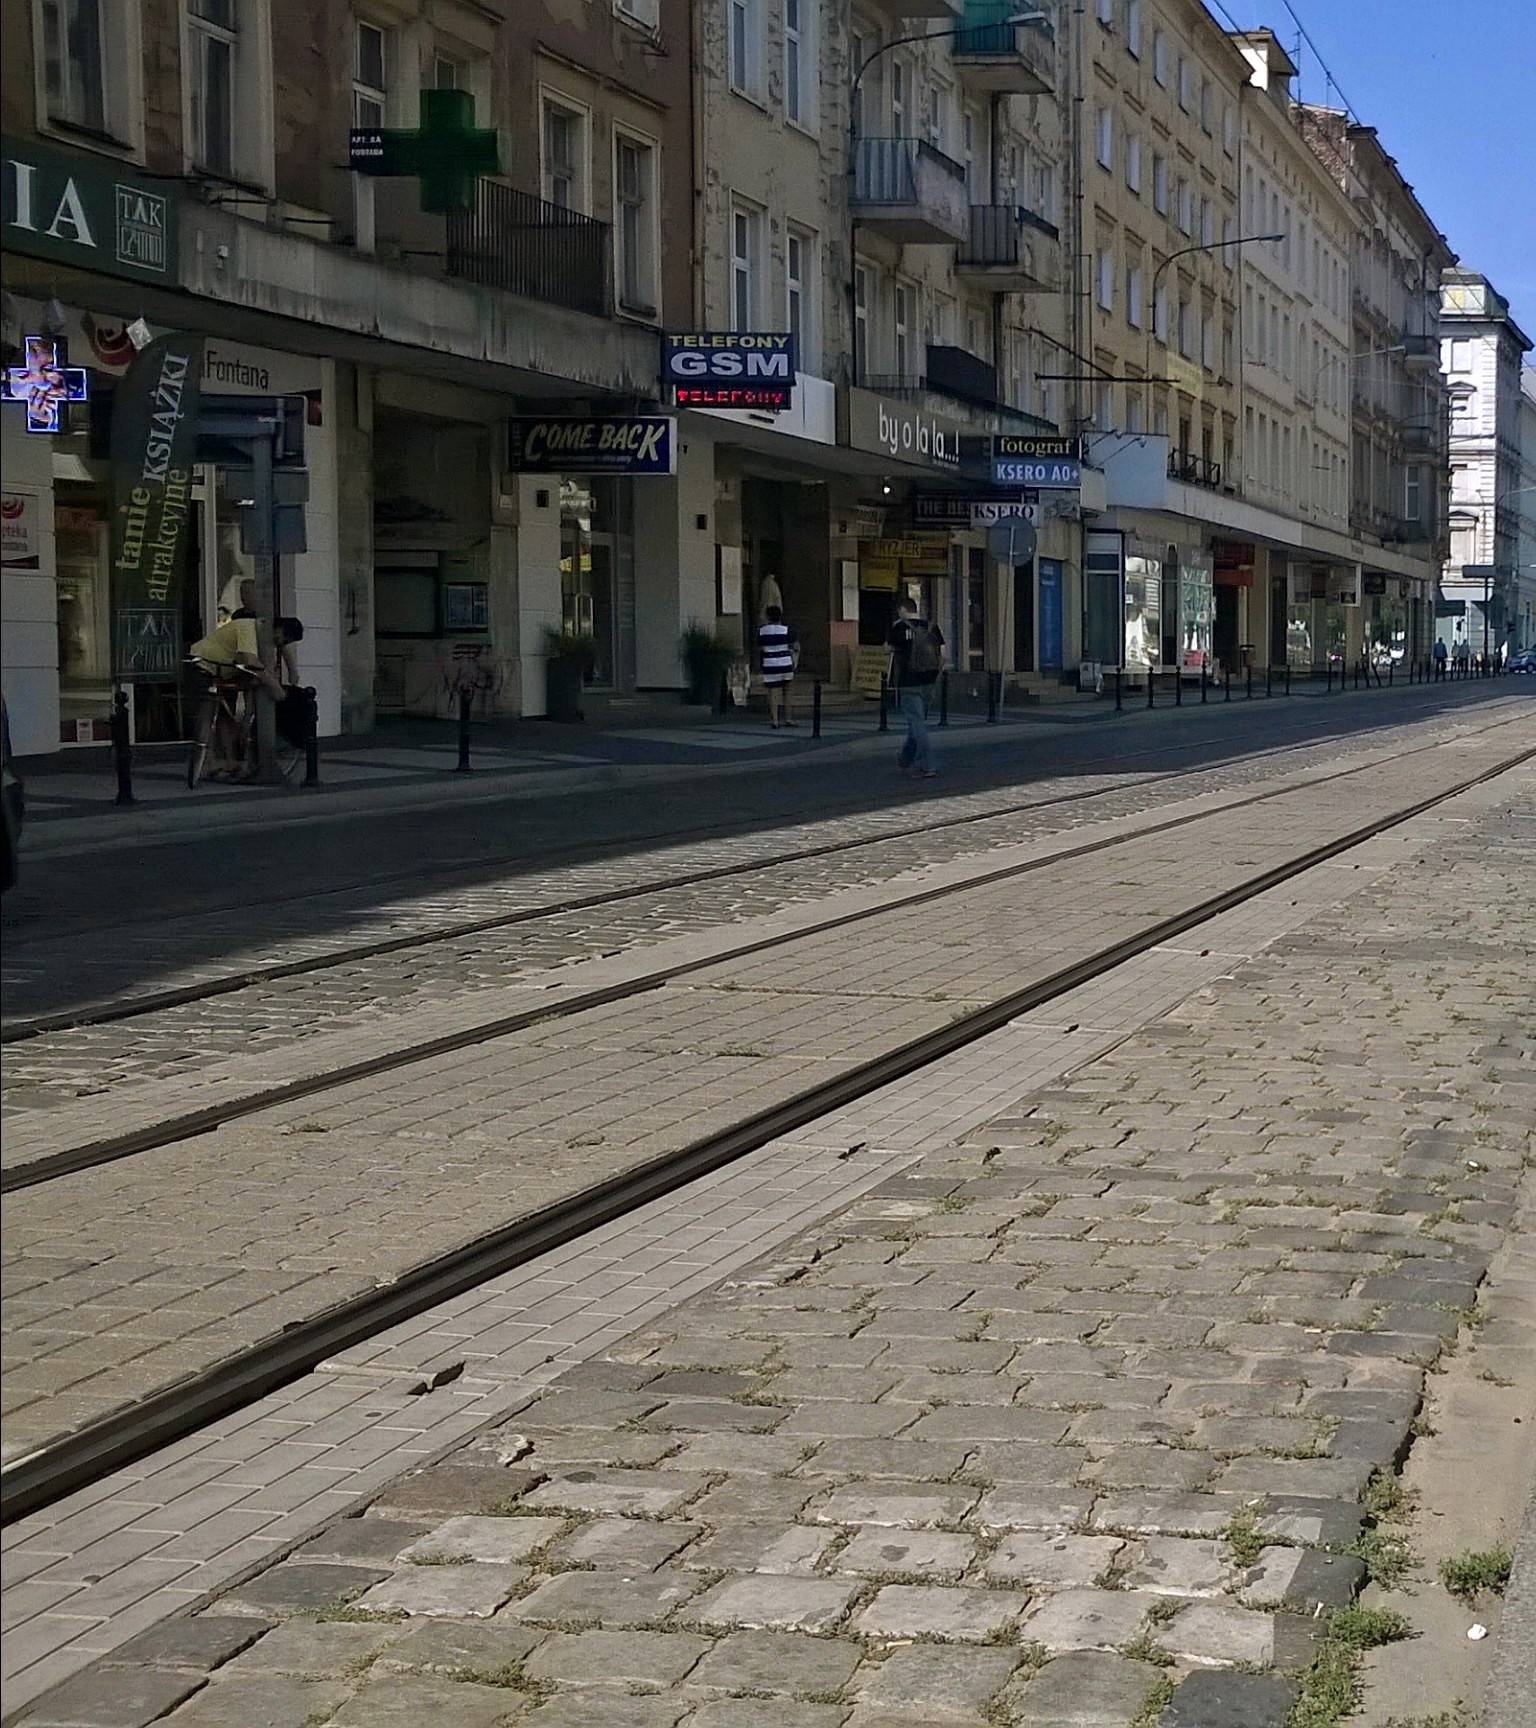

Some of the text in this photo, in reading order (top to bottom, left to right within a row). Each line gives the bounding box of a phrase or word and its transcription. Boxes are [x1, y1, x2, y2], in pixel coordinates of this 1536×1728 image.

[668, 335, 789, 349] TELEFONY
[206, 351, 269, 389] Fontana
[670, 351, 789, 377] GSM
[142, 351, 189, 484] KSIĄŻKI
[879, 402, 899, 455] by
[902, 421, 912, 449] o
[915, 414, 929, 454] la
[524, 422, 596, 461] COME
[598, 423, 666, 461] BACK
[1000, 437, 1074, 457] fotograf
[996, 463, 1046, 481] KSERO
[974, 504, 1034, 519] KSERO
[114, 486, 151, 571] tanie
